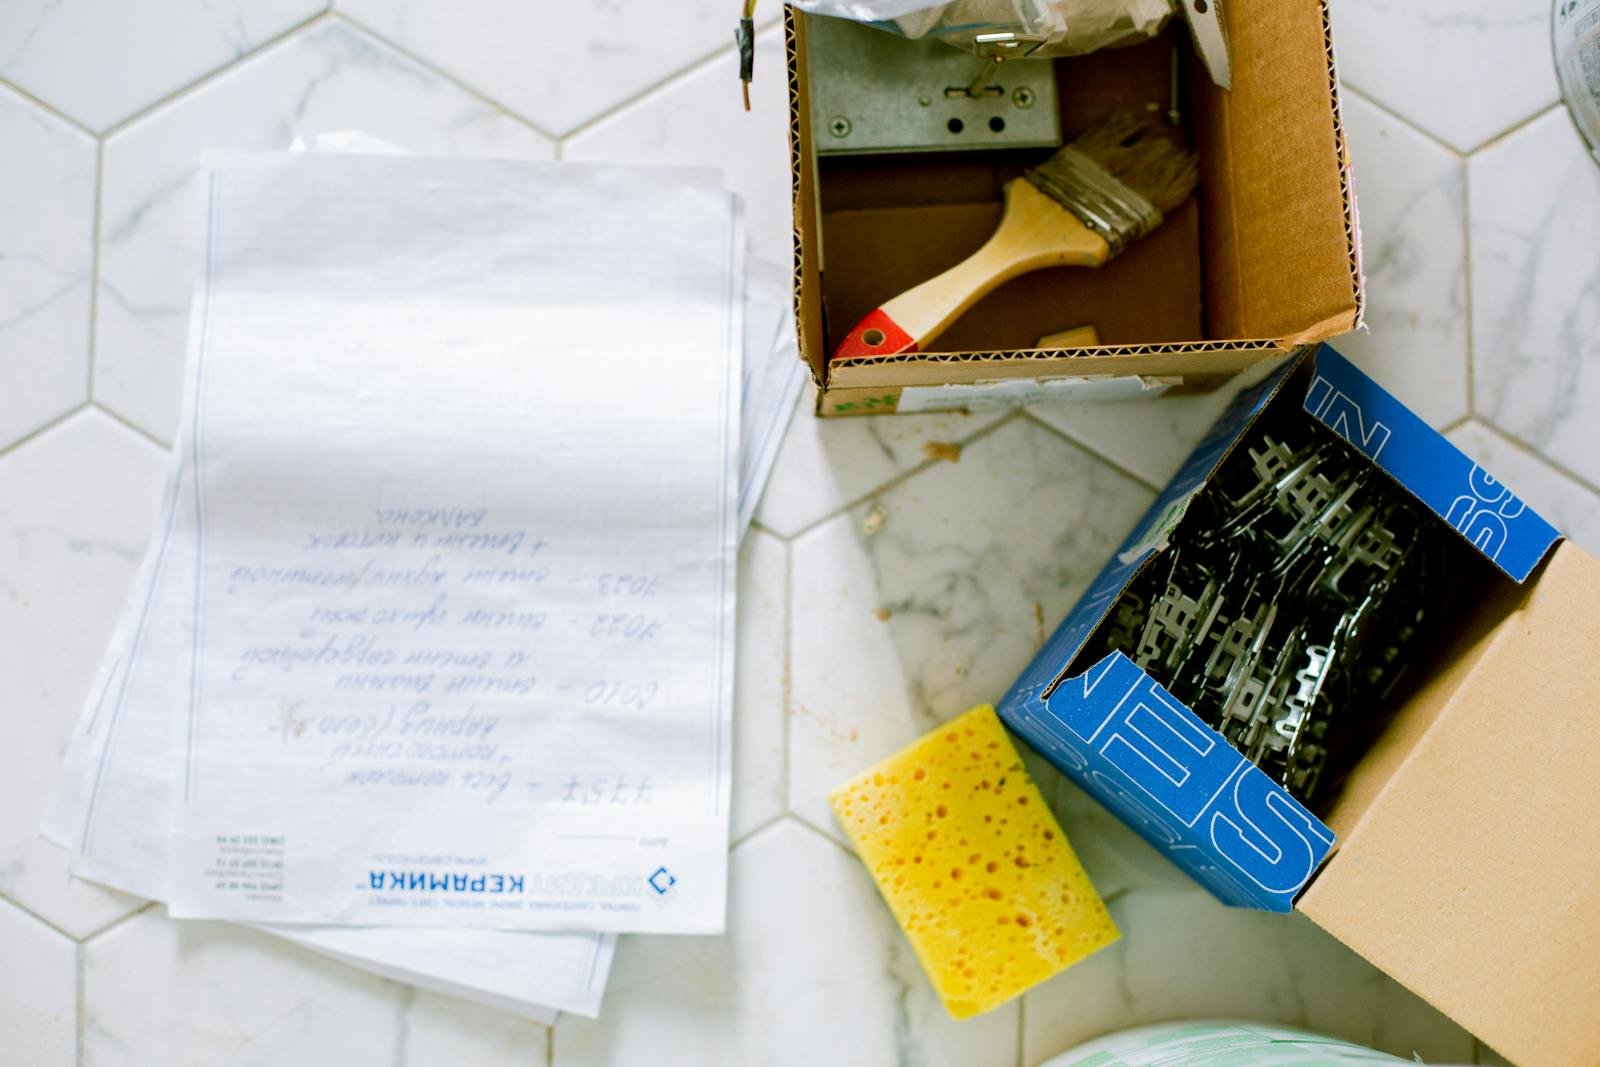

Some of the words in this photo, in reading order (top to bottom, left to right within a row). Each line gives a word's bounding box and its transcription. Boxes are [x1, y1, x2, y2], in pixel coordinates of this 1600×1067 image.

[597, 573, 664, 597] 7023
[590, 612, 662, 641] 7022
[583, 679, 658, 708] 6010
[559, 775, 654, 805] 7757
[369, 870, 524, 894] КЕРАМИКА
